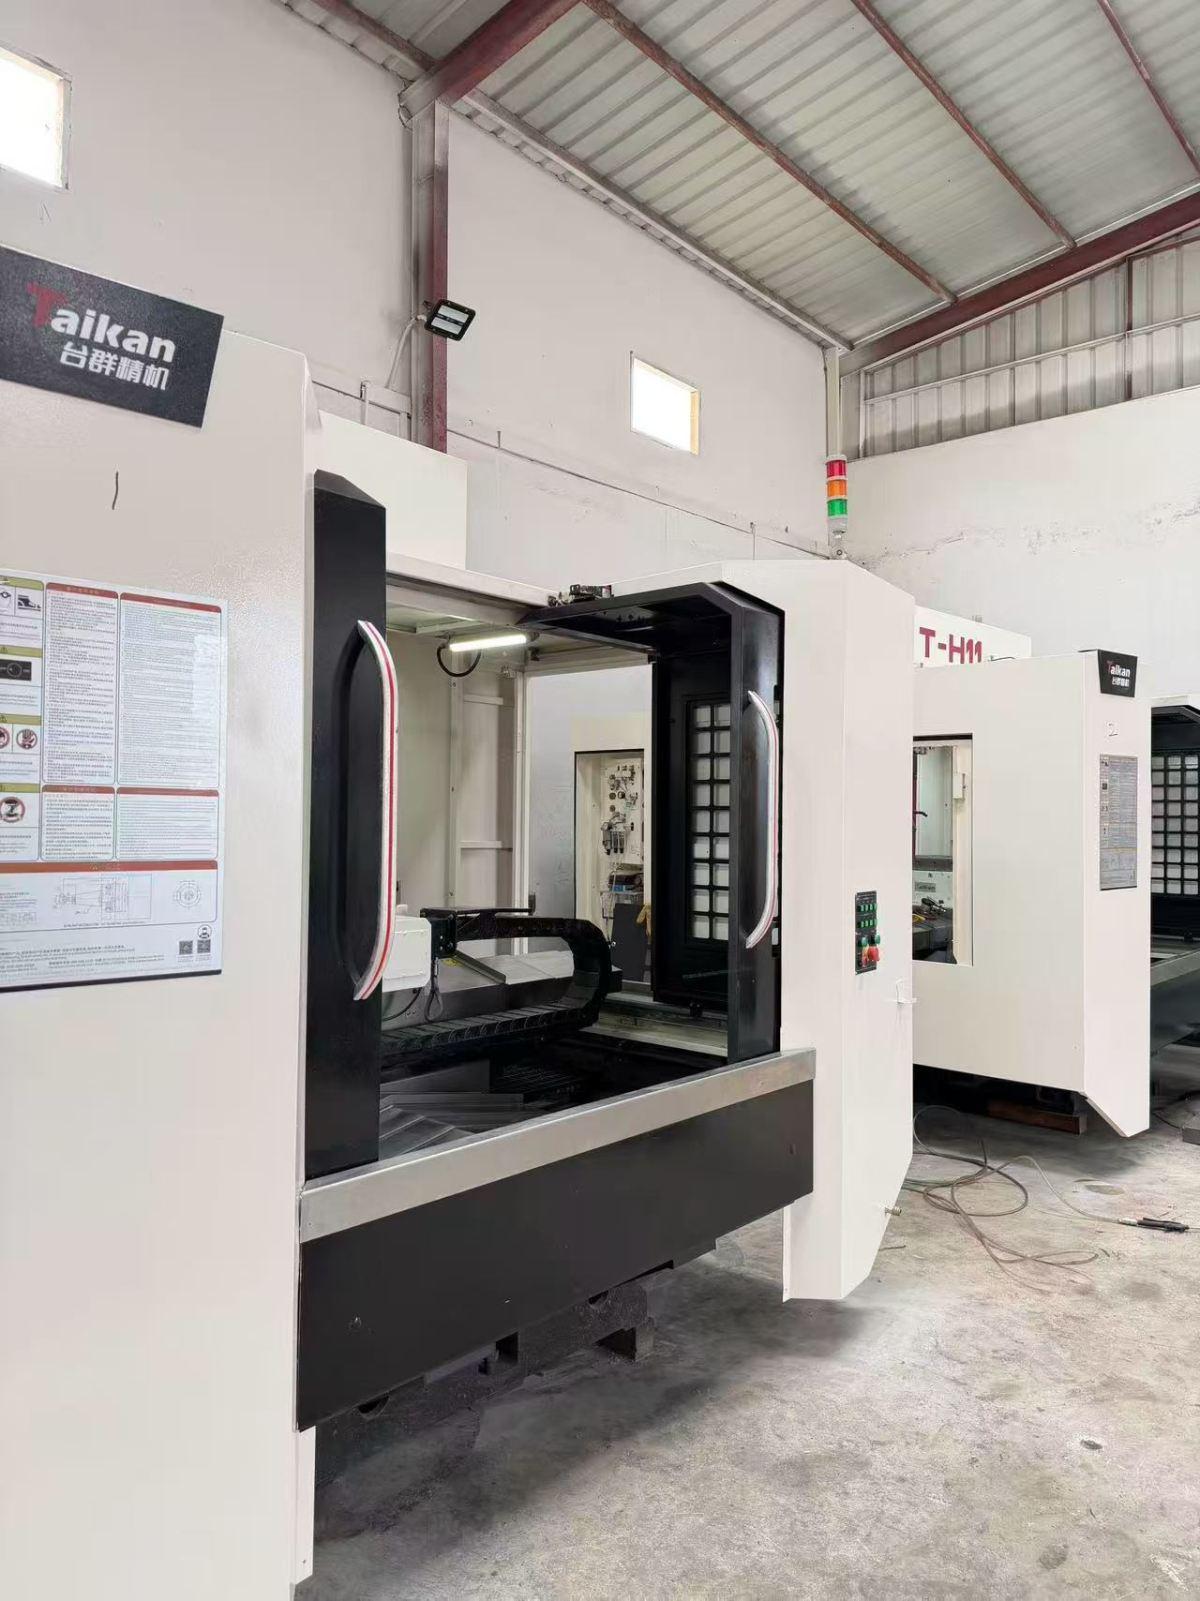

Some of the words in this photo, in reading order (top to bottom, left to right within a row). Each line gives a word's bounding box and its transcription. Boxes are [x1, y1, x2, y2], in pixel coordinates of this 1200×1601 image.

[26, 281, 175, 363] Taikan
[59, 341, 170, 391] 台群精机
[919, 626, 982, 664] T-H11
